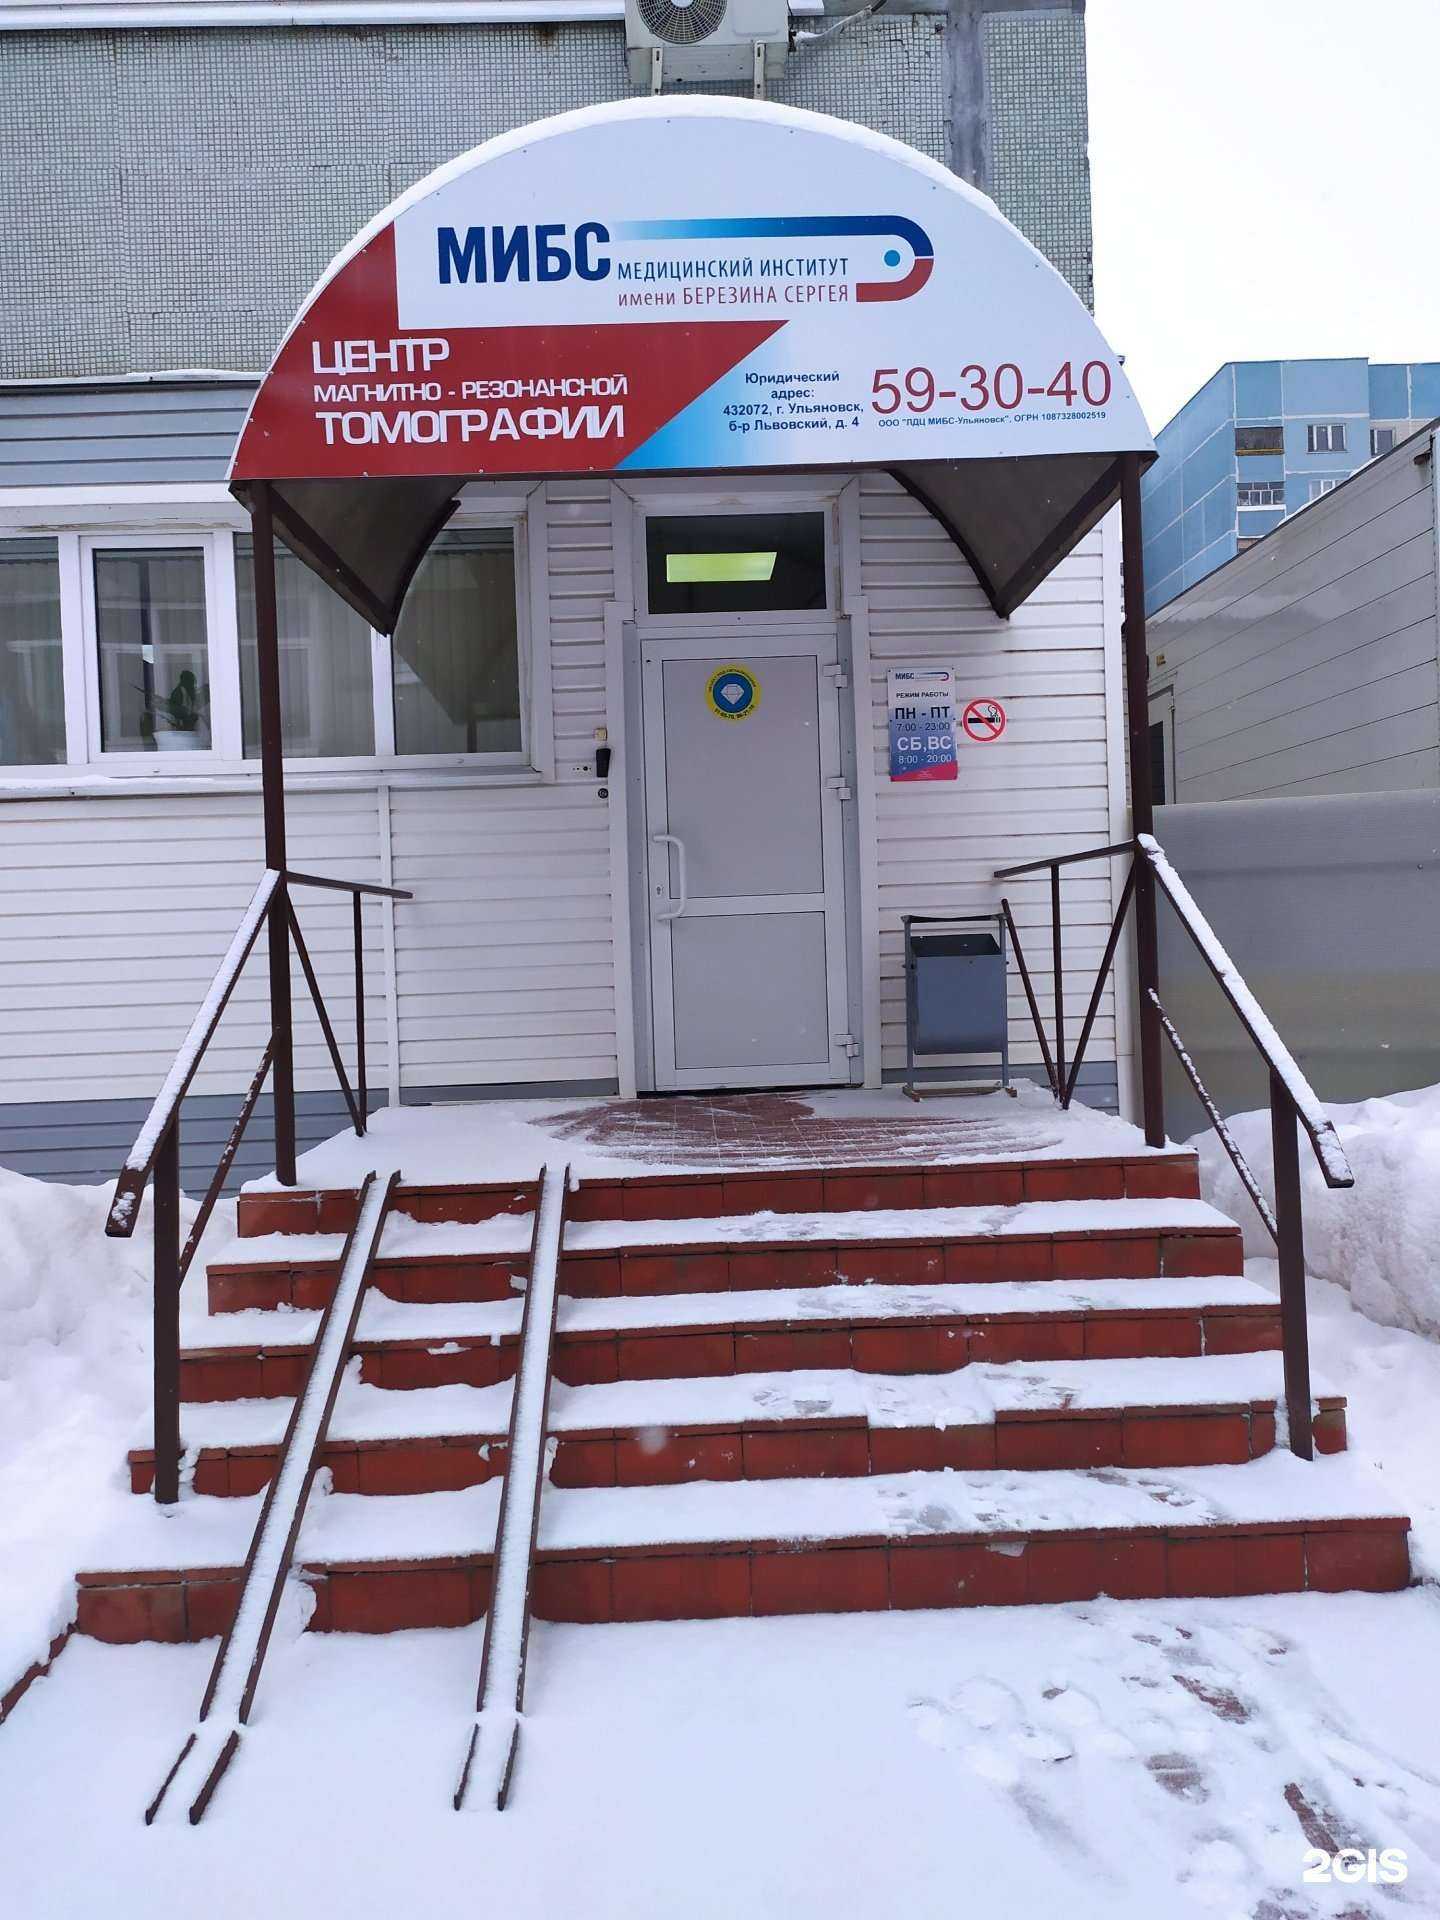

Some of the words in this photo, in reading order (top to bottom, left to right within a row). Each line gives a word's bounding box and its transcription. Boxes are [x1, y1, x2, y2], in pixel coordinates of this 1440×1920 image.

[437, 221, 611, 285] МИБС
[618, 257, 752, 282] МЕДИЦИНСКИЙ
[760, 257, 849, 278] ИНСТИТУТ
[618, 291, 675, 307] имени
[684, 285, 777, 305] БЕРЕЗИНА
[784, 284, 848, 303] СЕРГЕЯ
[312, 338, 450, 377] ЦЕНТР
[745, 370, 840, 386] Юридический
[313, 382, 441, 402] МАГНИТНО
[462, 374, 629, 400] РЕЗОНАНСНОЙ
[771, 388, 815, 401] адрес:
[871, 360, 1112, 415] 59-30-40
[723, 403, 773, 417] 432072,
[776, 405, 785, 415] г.
[788, 402, 864, 415] Ульяновск,
[315, 405, 625, 446] ТОМОГРАФИИ
[728, 420, 751, 433] б-р
[754, 417, 832, 431] Львовский,
[835, 419, 848, 430] д.
[851, 416, 860, 427] 4
[878, 418, 900, 428] ООО
[1014, 413, 1039, 423] ОГРН
[895, 672, 915, 680] МИБС
[895, 707, 916, 720] ПН
[930, 706, 951, 719] ПТ
[896, 723, 916, 732] 7:00
[925, 722, 950, 731] 23:00
[897, 735, 952, 753] СБ,ВС
[898, 755, 918, 764] 8:00
[927, 754, 952, 763] 20:00
